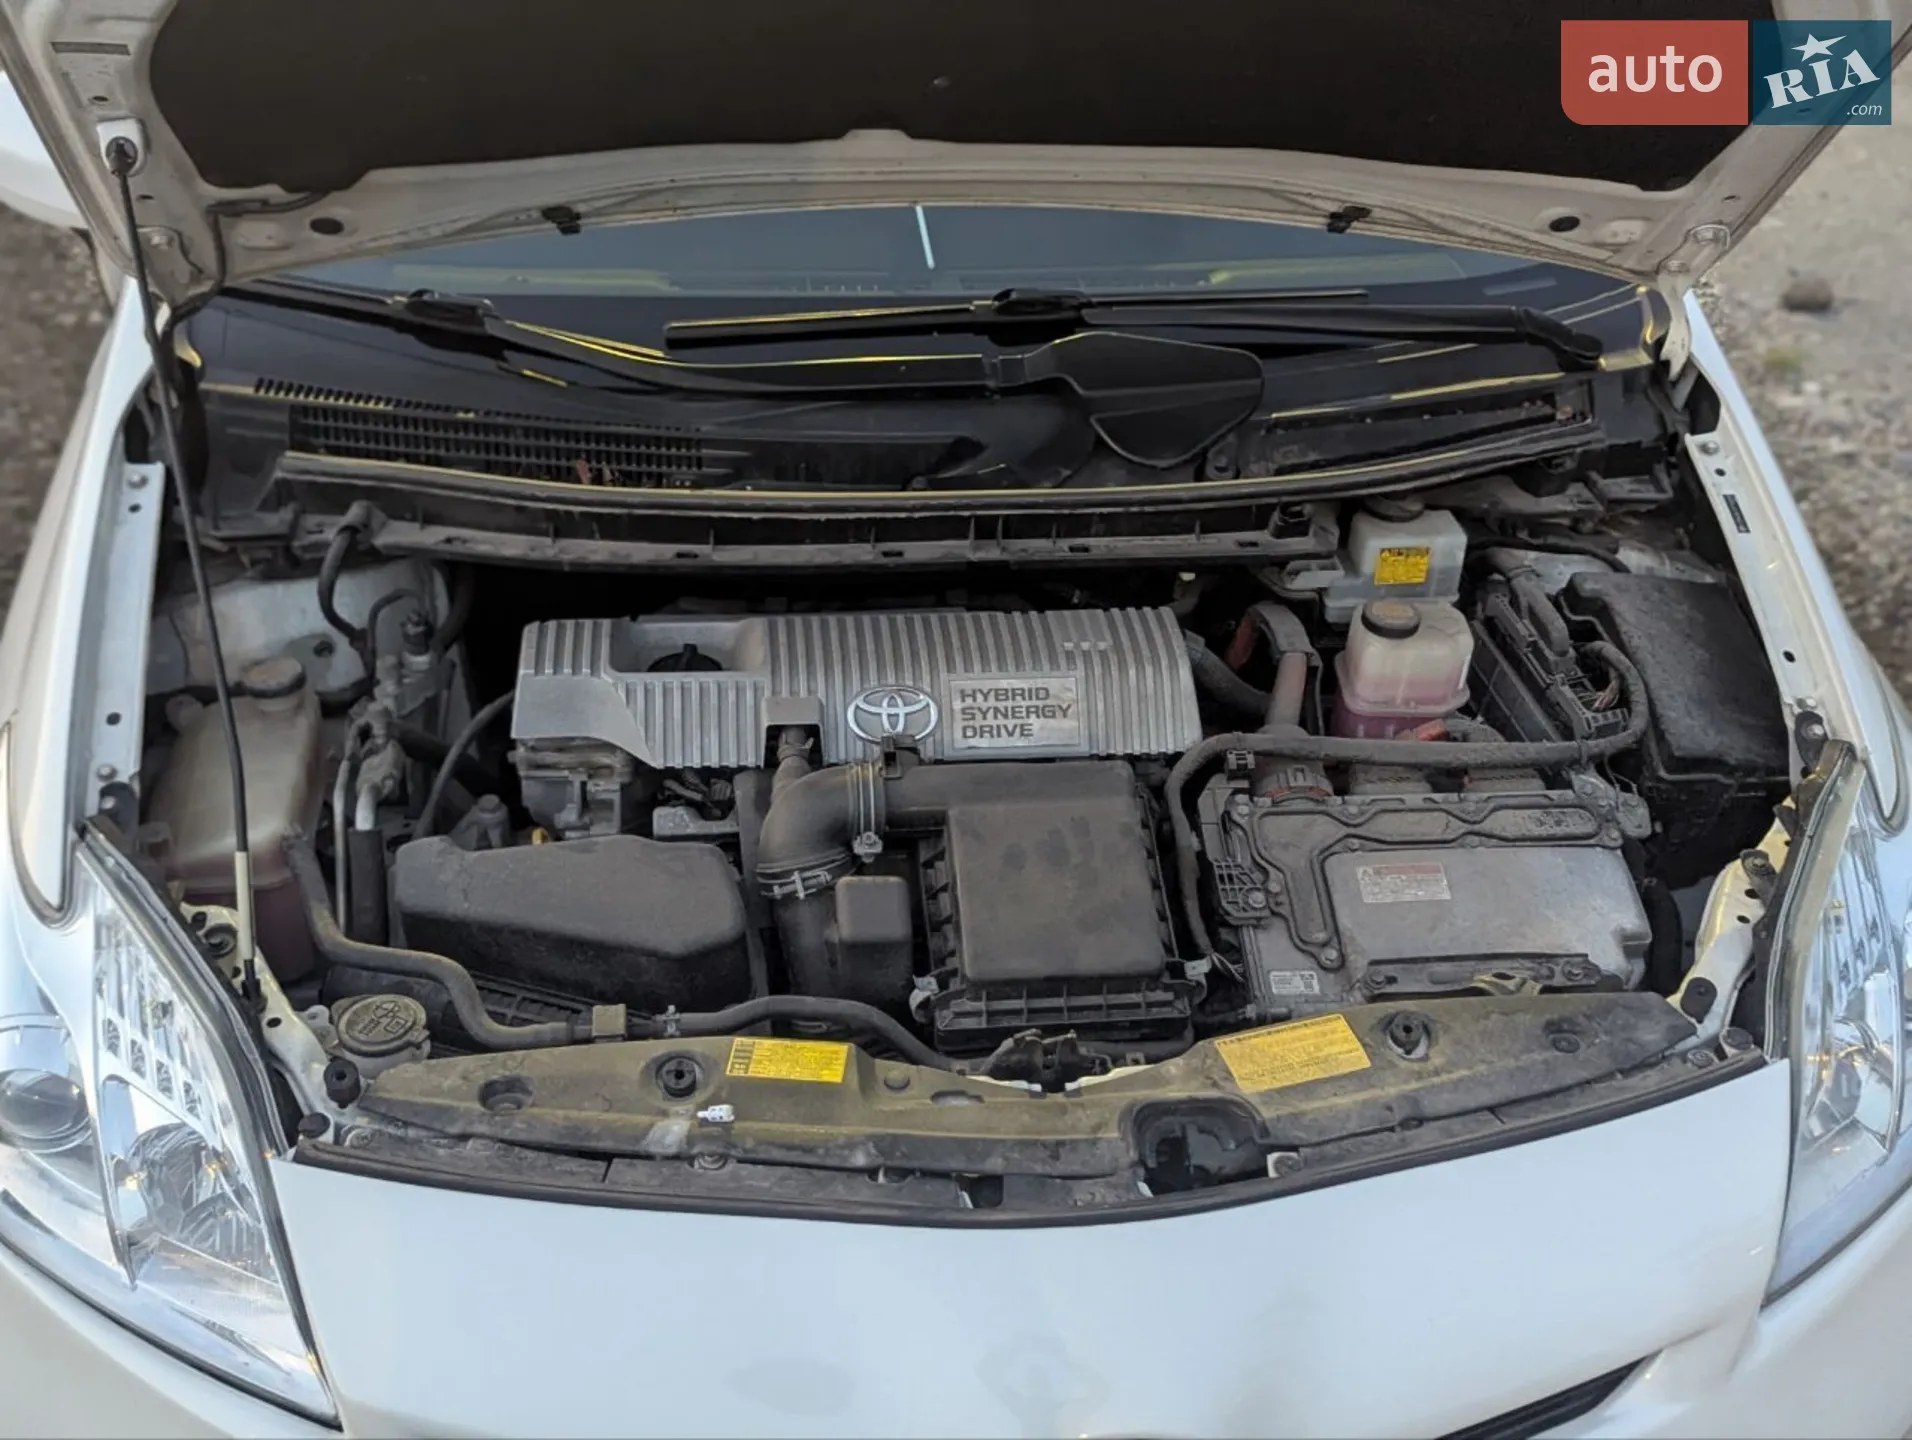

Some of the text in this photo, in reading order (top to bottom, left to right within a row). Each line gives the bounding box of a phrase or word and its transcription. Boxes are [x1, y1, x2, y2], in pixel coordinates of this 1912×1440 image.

[960, 686, 1050, 702] HYBRID
[961, 703, 1072, 721] SYNERGY
[962, 722, 1034, 739] DRIVE
